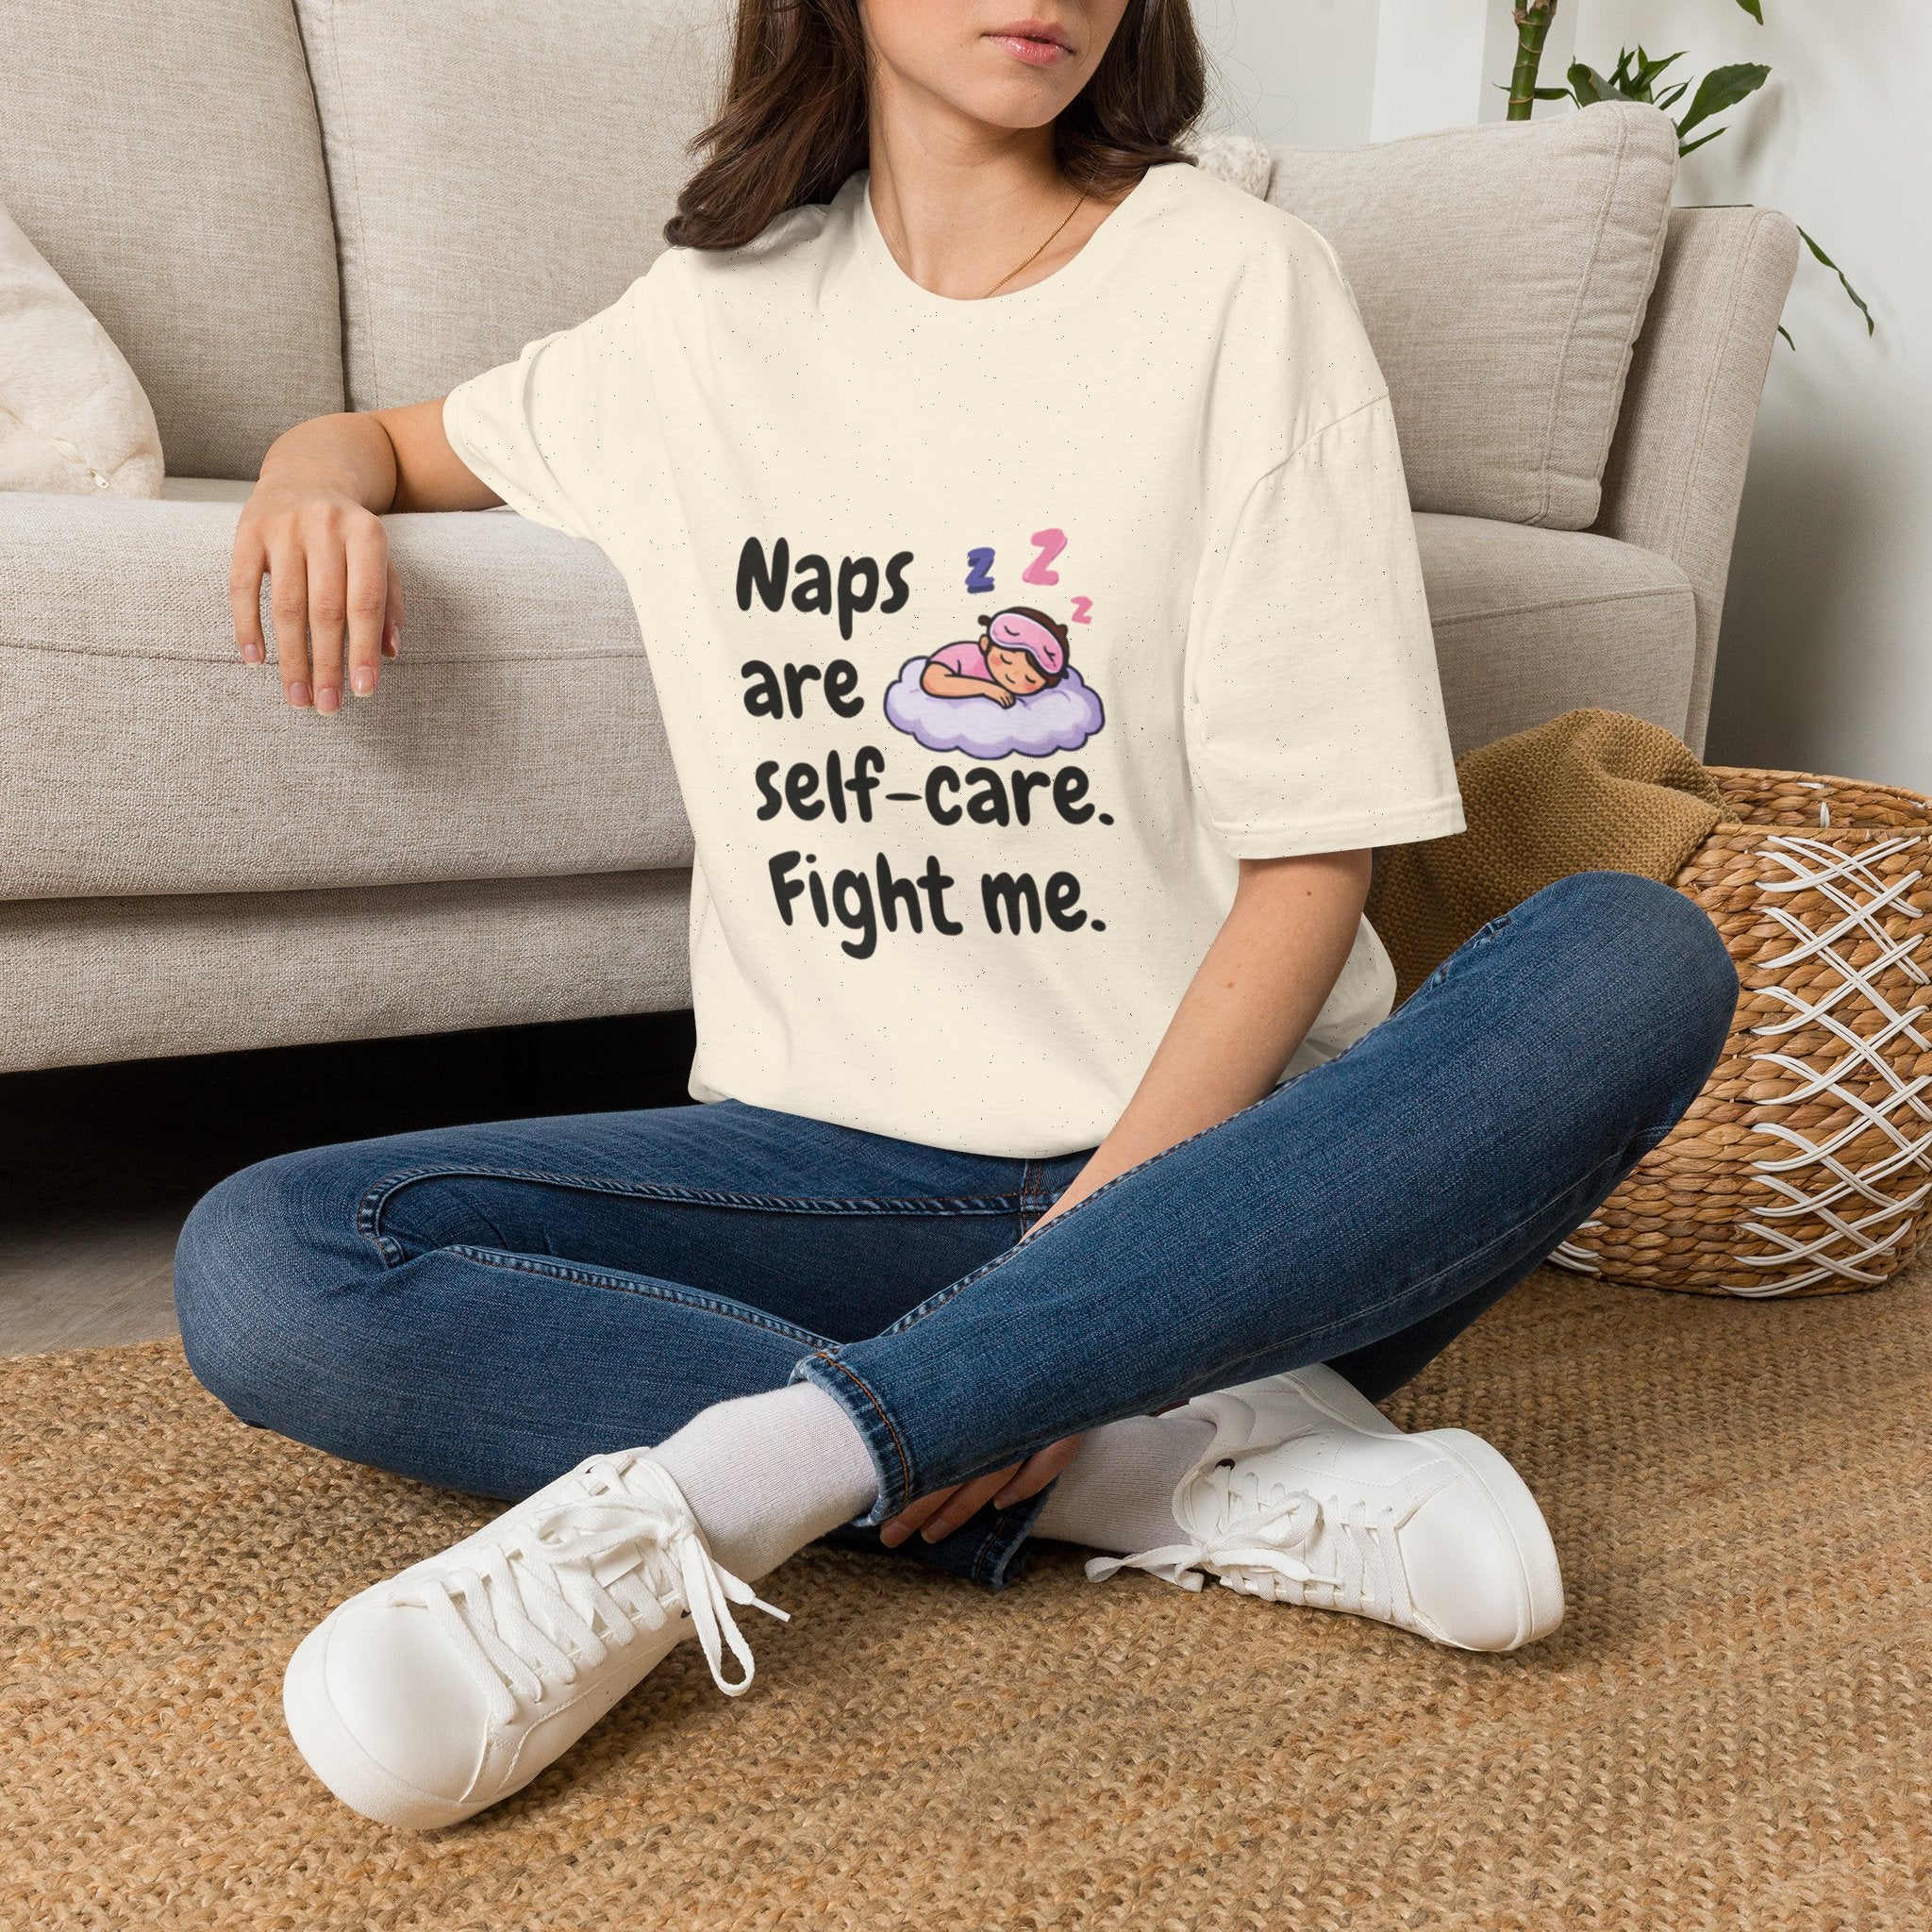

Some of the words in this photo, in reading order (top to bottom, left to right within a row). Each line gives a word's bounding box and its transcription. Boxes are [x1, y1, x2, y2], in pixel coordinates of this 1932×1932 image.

[735, 536, 915, 641] Naps
[741, 658, 865, 721] are
[755, 744, 1115, 828] self-care.
[768, 850, 964, 960] Fight
[980, 871, 1108, 937] me.
